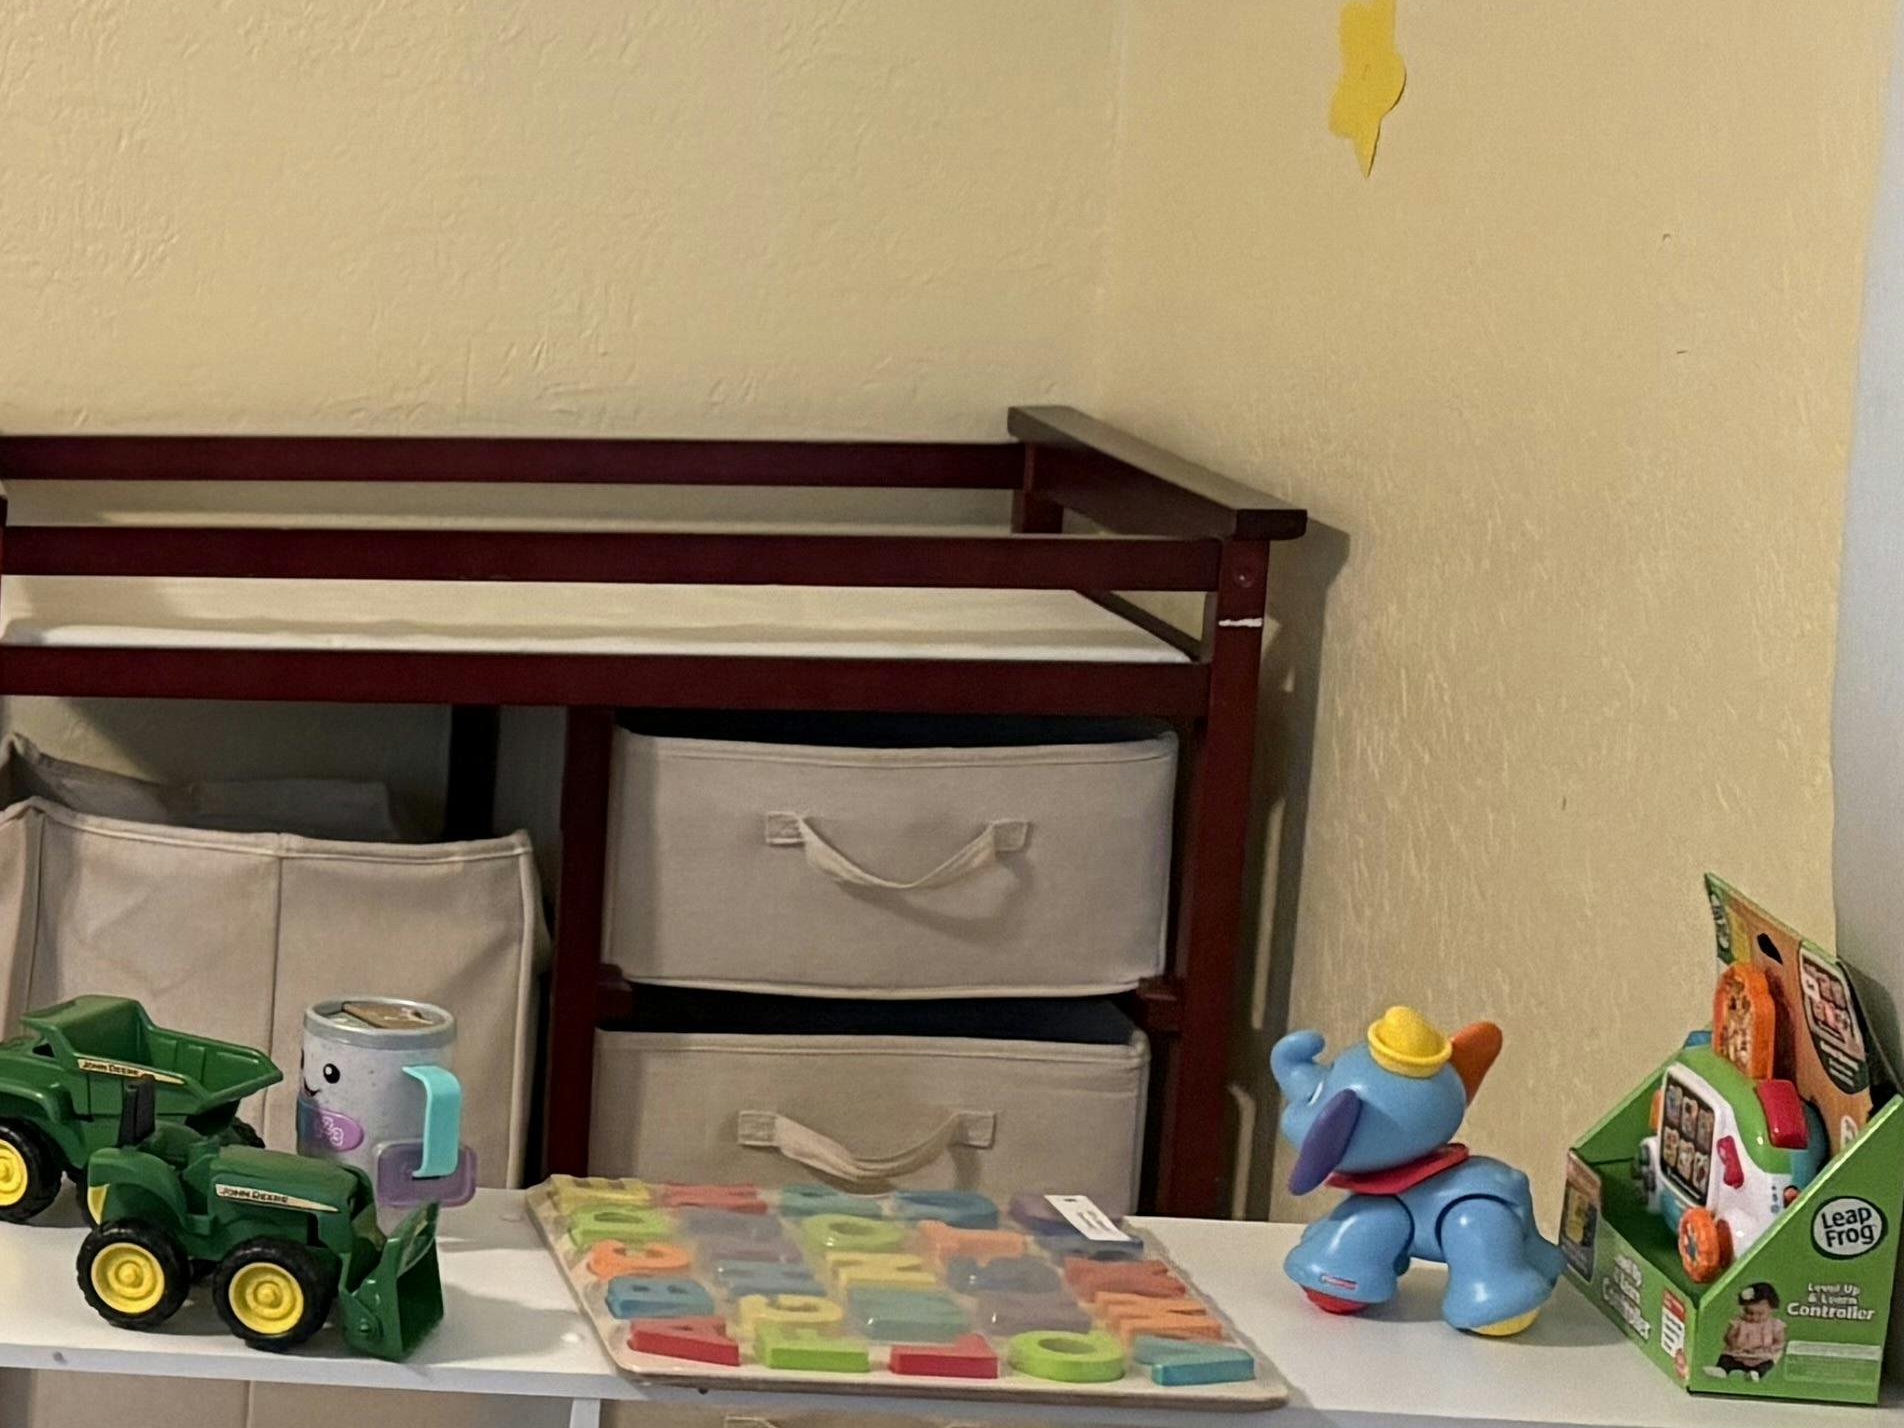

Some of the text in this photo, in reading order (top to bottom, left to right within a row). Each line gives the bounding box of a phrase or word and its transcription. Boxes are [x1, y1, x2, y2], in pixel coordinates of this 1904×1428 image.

[83, 1061, 108, 1071] JOHN
[219, 1187, 288, 1203] JOHN DEERE
[1821, 1207, 1872, 1229] Leap
[1826, 1224, 1875, 1248] Frog
[1844, 1283, 1860, 1295] Up
[1787, 1302, 1875, 1321] Controller
